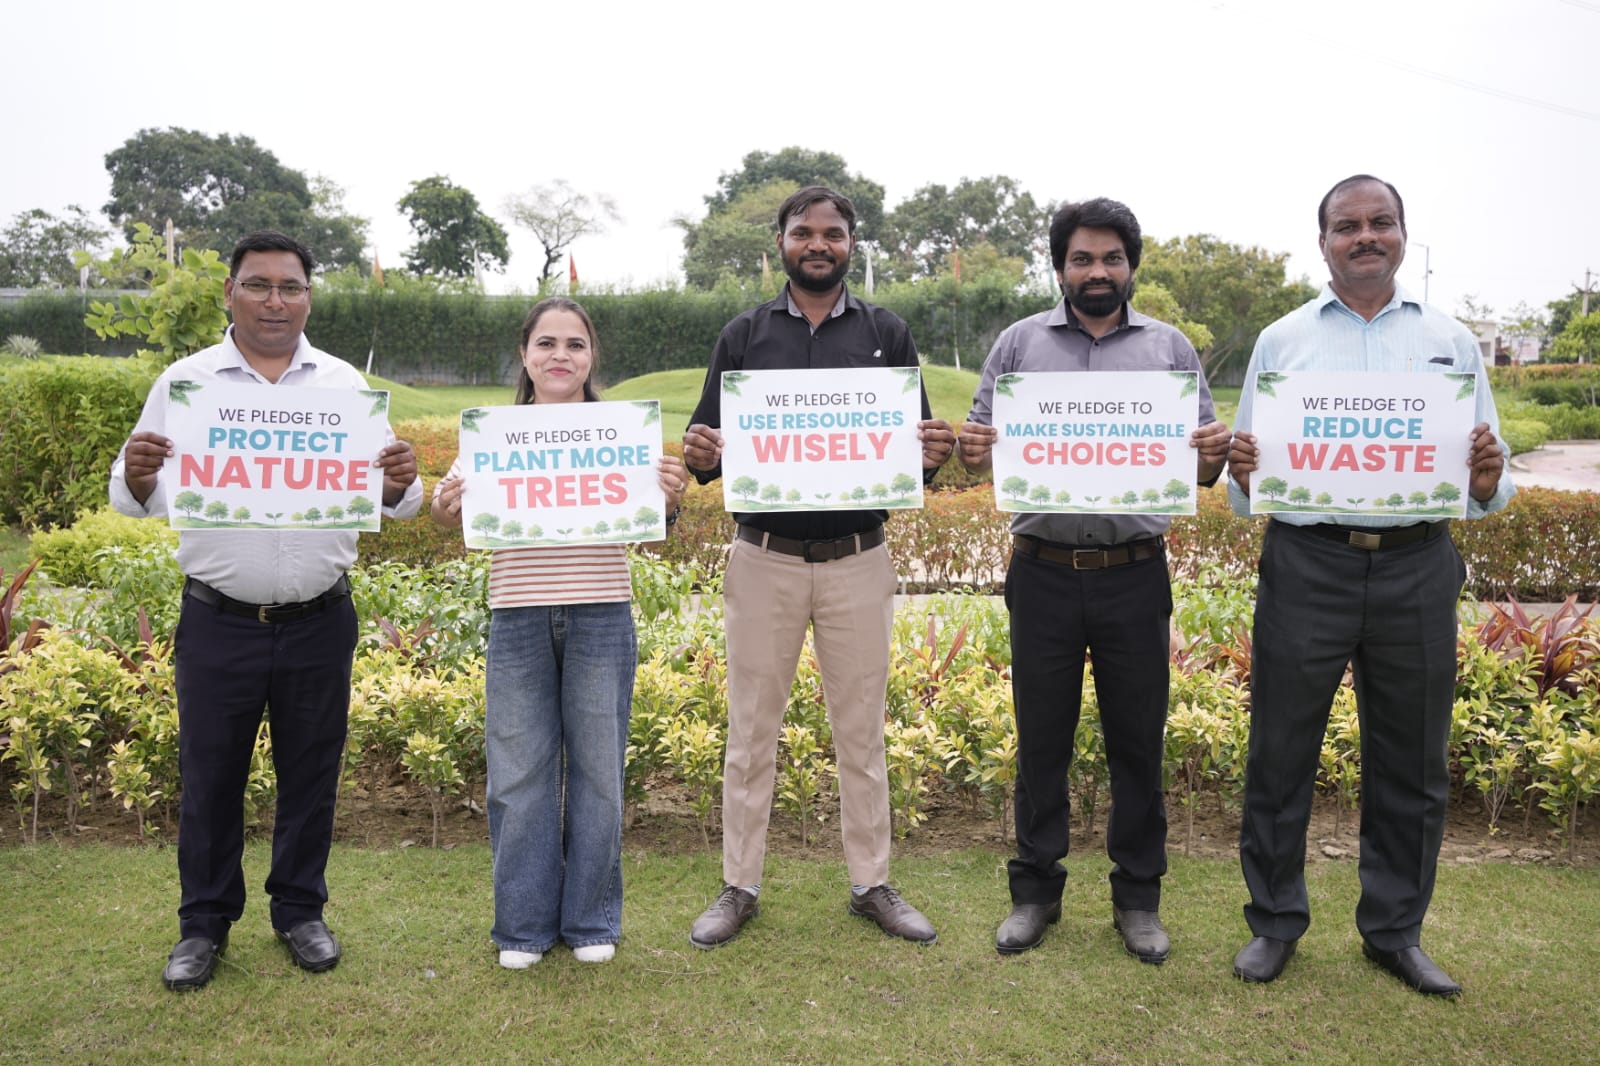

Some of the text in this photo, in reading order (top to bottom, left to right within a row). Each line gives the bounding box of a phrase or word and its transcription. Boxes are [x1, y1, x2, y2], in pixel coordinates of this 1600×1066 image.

[766, 392, 876, 406] WE PLEDGE TO
[1039, 402, 1152, 414] WE PLEDGE TO
[1303, 397, 1425, 411] WE PLEDGE TO
[219, 408, 341, 426] WE PLEDGE TO
[739, 411, 904, 430] USE RESOURCES
[1303, 416, 1423, 439] REDUCE
[208, 427, 348, 453] PROTECT
[506, 428, 617, 445] WE PLEDGE TO
[1006, 423, 1185, 437] MAKE SUSTAINABLE
[474, 445, 650, 472] PLANT MORE
[752, 432, 892, 463] WISELY
[1023, 442, 1166, 466] CHOICES
[1288, 443, 1436, 473] WASTE
[180, 454, 370, 491] NATURE
[498, 473, 628, 509] TREES
